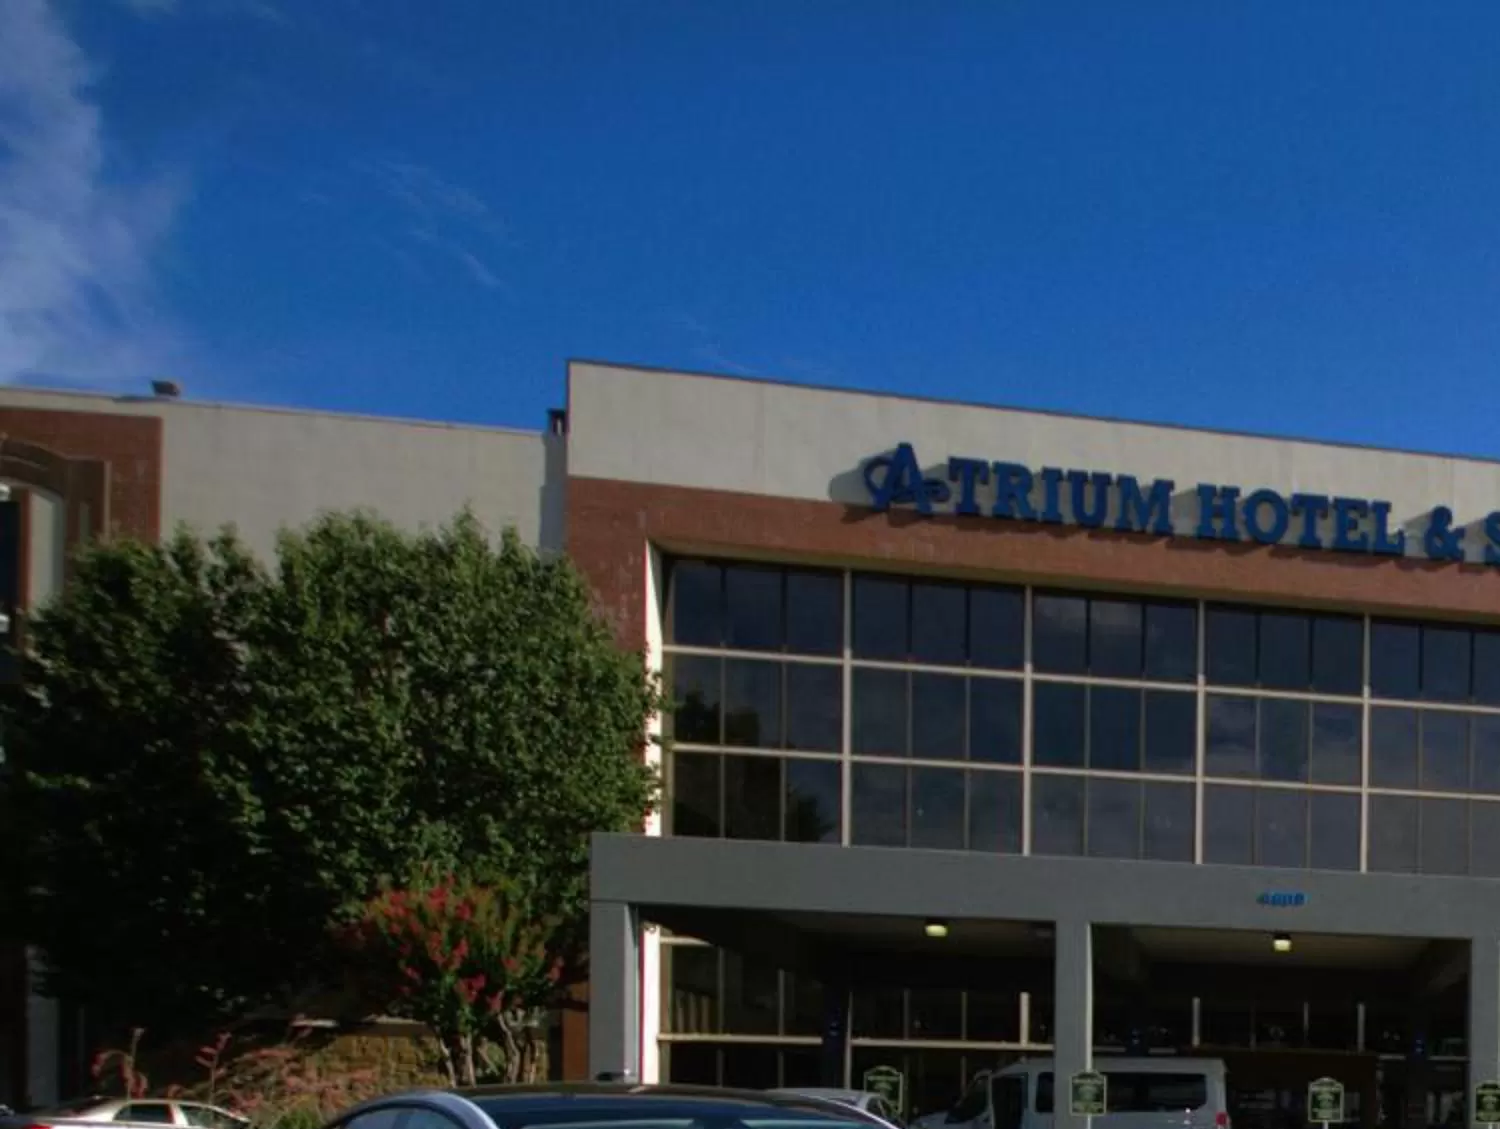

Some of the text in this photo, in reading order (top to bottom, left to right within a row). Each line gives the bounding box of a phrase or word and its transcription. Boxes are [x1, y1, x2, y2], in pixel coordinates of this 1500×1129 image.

[863, 442, 1175, 536] ATRIUM
[1195, 484, 1405, 557] HOTEL
[1424, 505, 1465, 561] &
